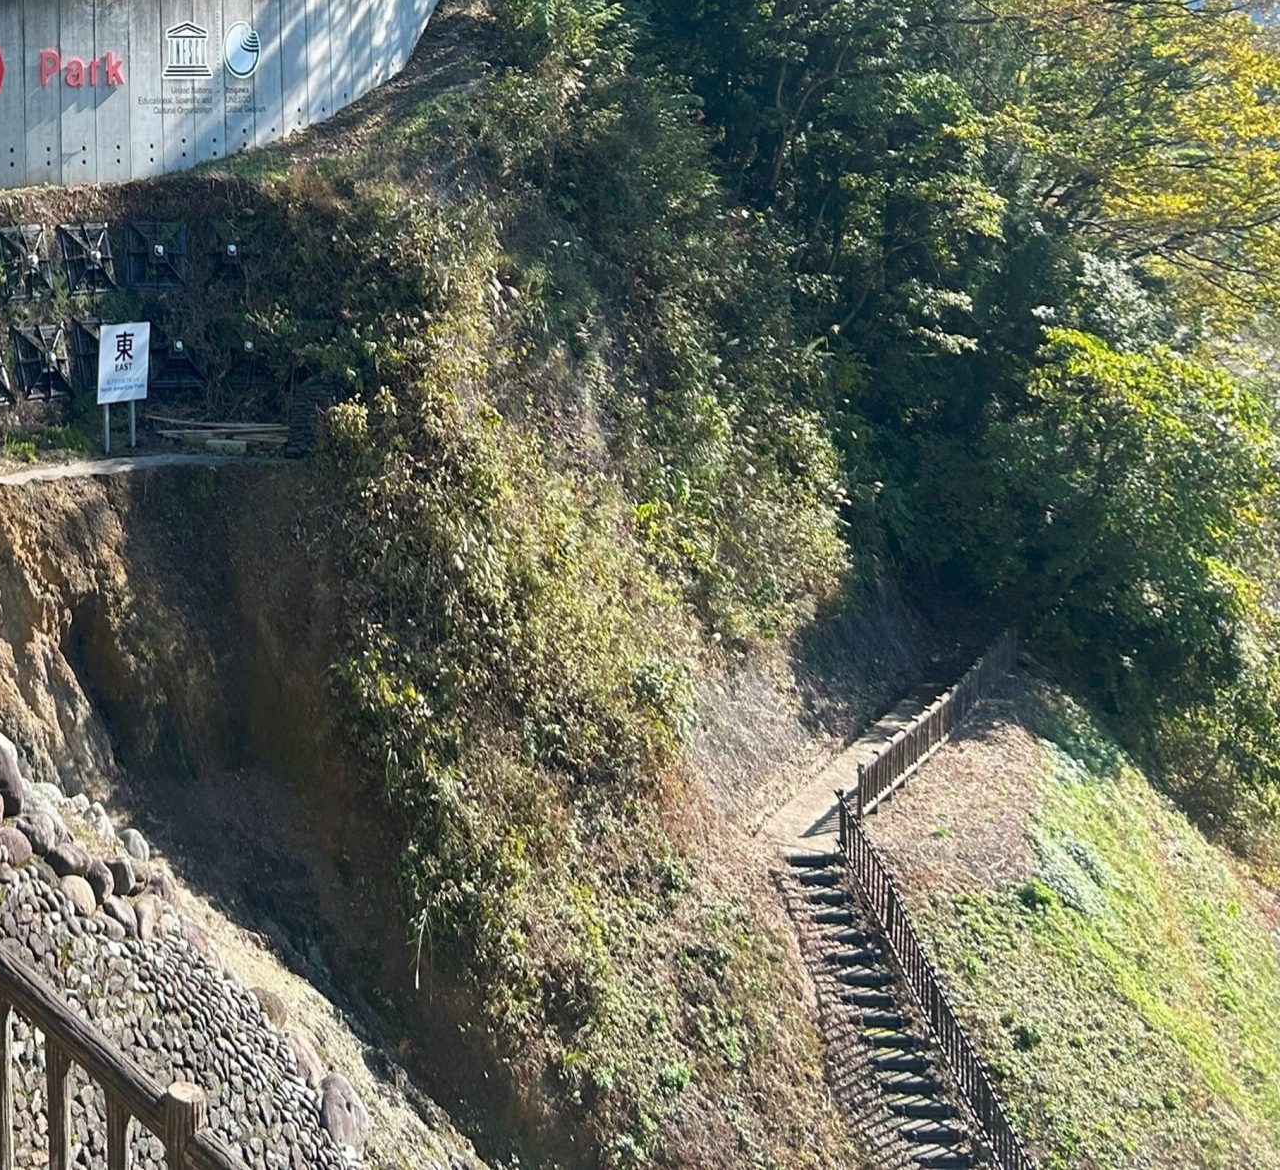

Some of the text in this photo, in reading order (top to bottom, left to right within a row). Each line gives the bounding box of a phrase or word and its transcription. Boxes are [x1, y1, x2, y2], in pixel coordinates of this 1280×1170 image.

[39, 48, 125, 89] Park
[115, 330, 134, 362] 東
[114, 362, 133, 372] EAST
